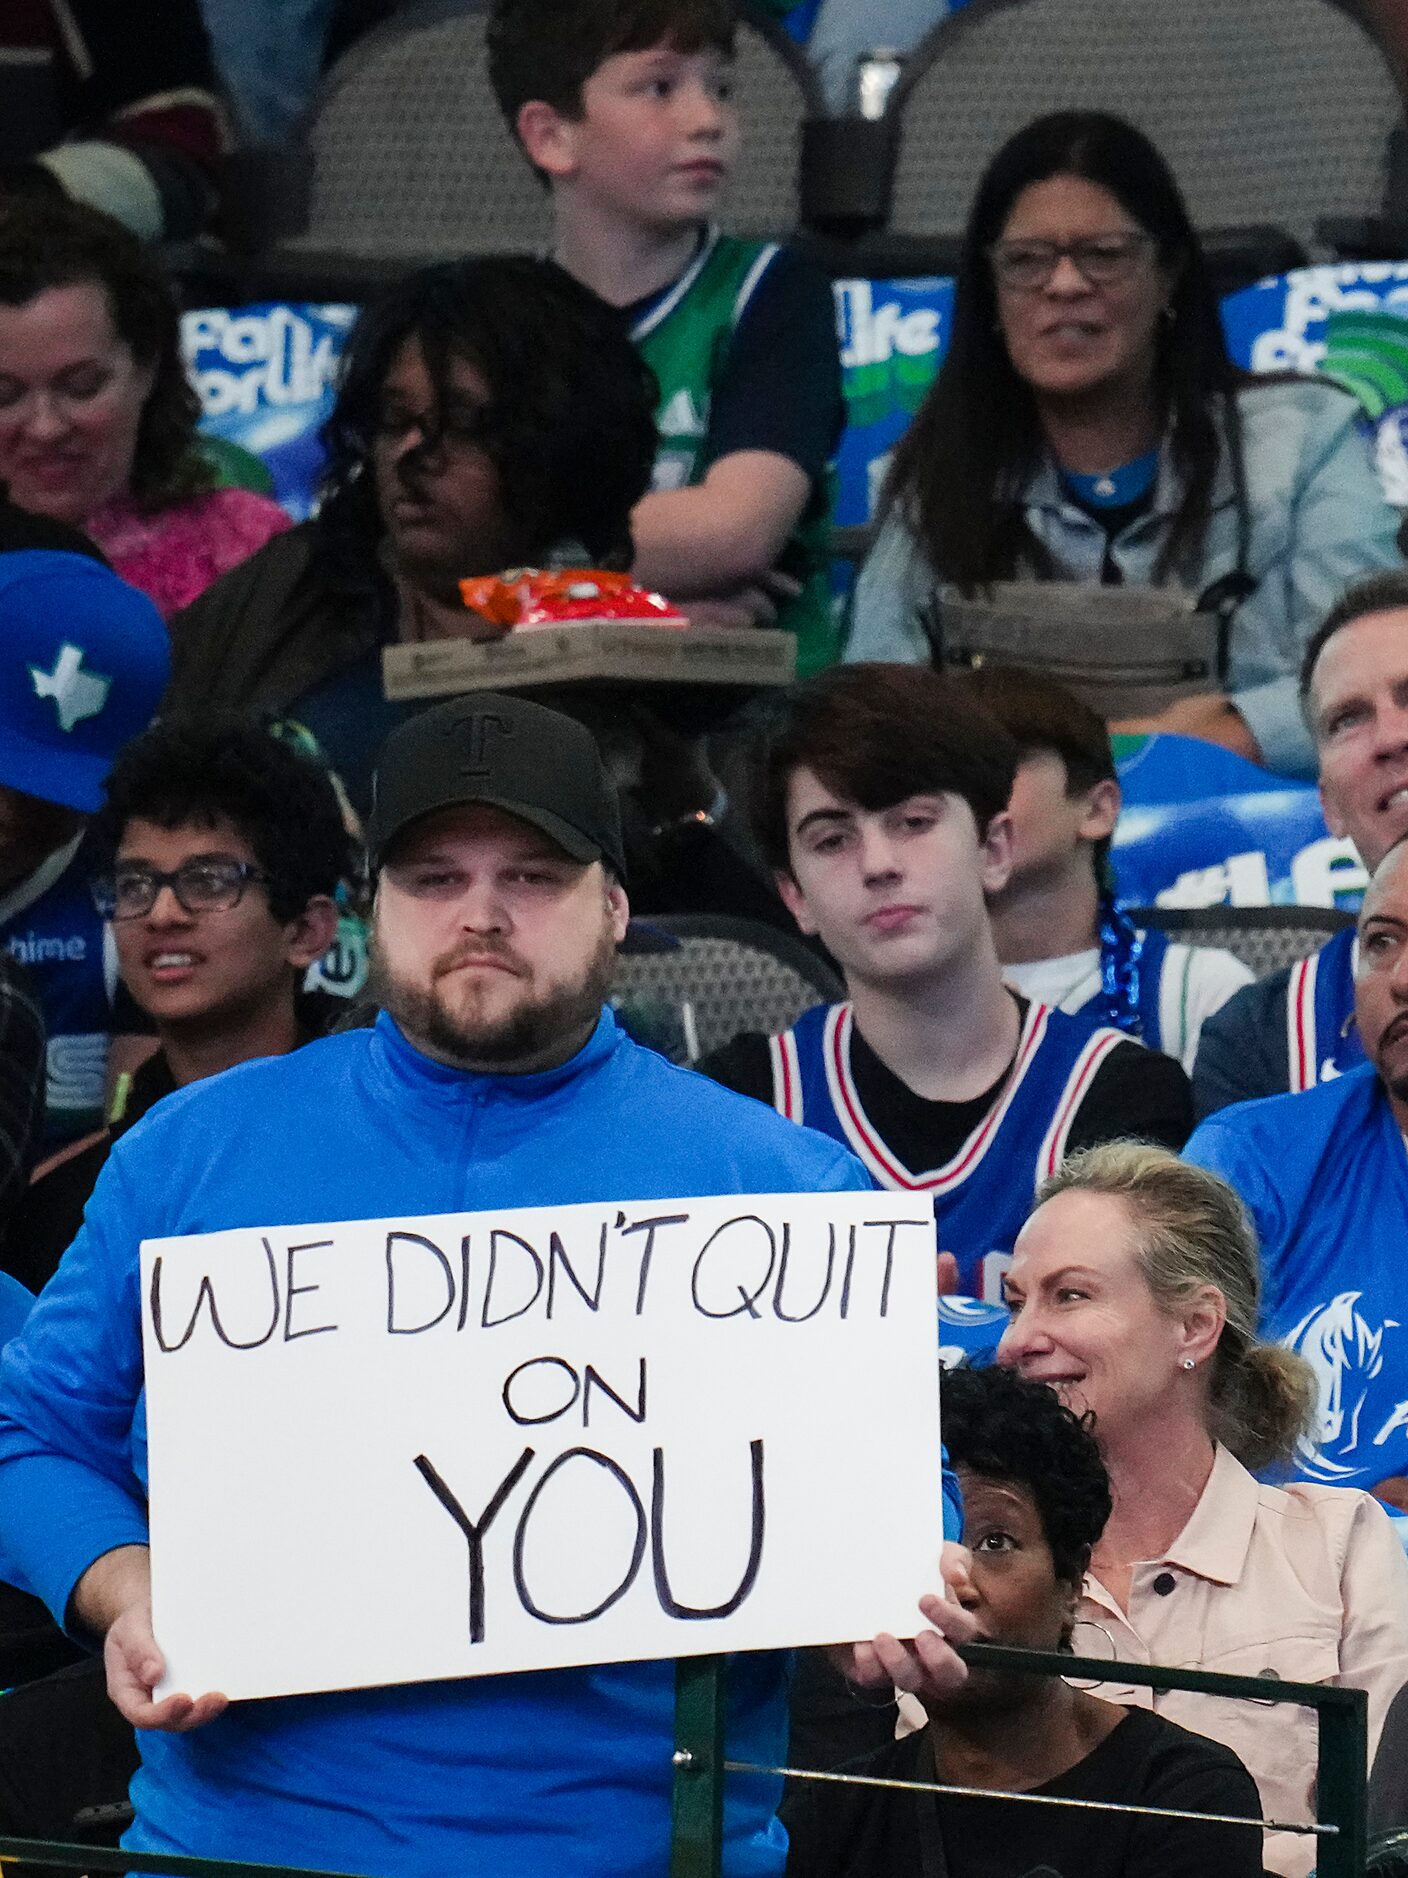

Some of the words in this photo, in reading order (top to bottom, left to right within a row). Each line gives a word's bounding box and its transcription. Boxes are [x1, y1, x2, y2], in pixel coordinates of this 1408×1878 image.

[151, 1236, 340, 1353] WE
[386, 1211, 690, 1335] DIDN'T
[690, 1215, 929, 1323] QUIT
[501, 1356, 648, 1428] ON
[412, 1438, 765, 1645] YOU
